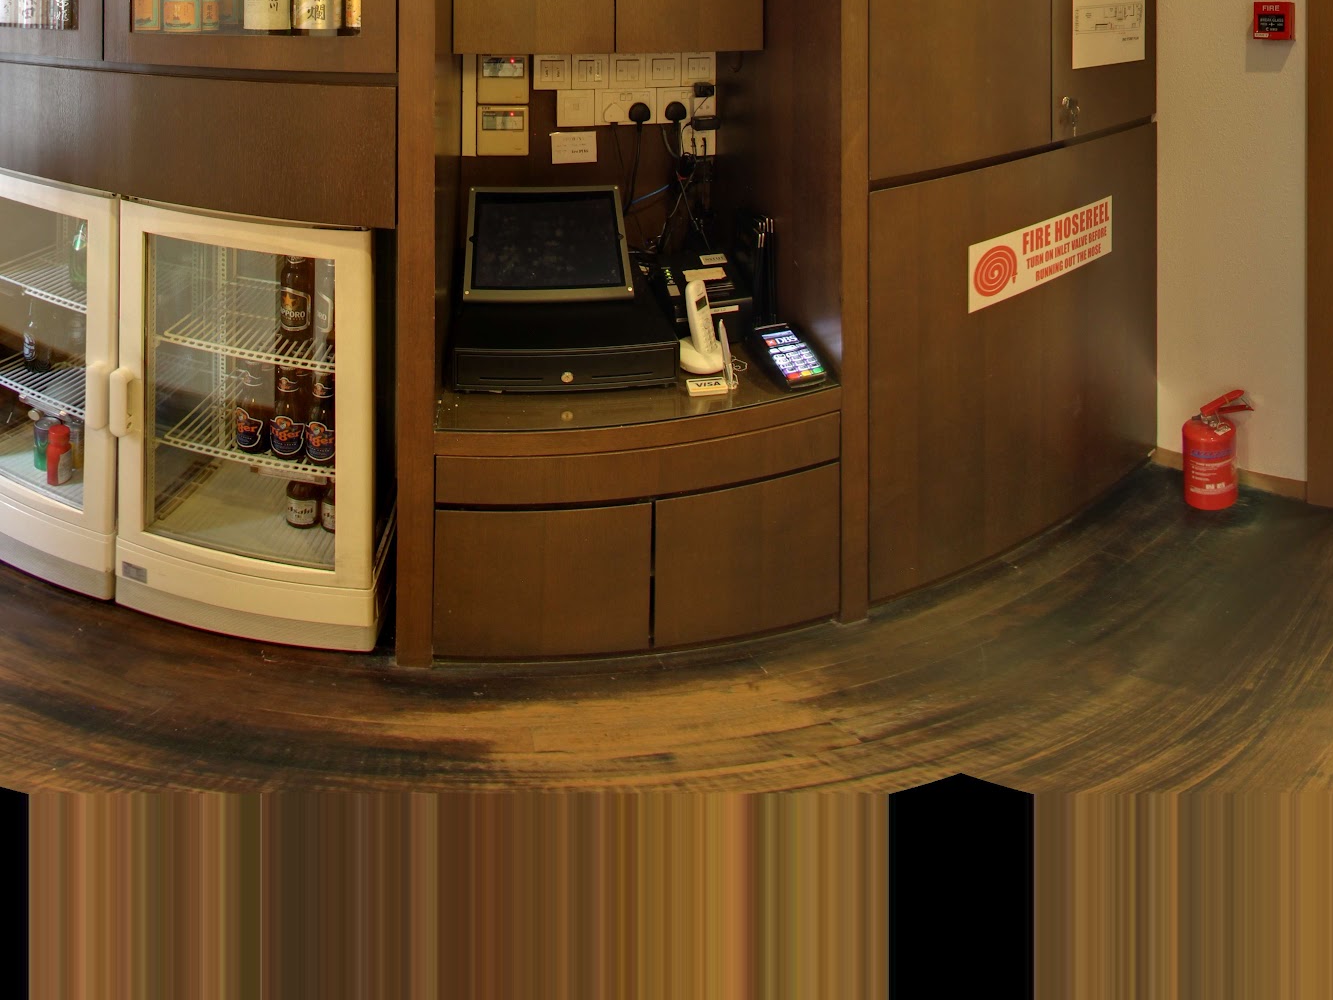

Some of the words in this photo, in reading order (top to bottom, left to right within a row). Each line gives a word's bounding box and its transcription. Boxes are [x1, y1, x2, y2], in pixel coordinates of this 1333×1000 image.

[1022, 223, 1051, 256] FIRE
[1055, 202, 1109, 242] HOSEREEL
[1026, 253, 1044, 269] TURN
[1045, 248, 1054, 262] ON
[1055, 242, 1070, 258] INLET
[1071, 234, 1088, 251] VALVE
[1088, 226, 1107, 244] BEFORE
[1036, 260, 1064, 282] RUNNING
[1064, 254, 1076, 269] OUT
[1076, 249, 1087, 263] THE
[1087, 243, 1102, 258] HOSE
[281, 307, 305, 318] PPORO
[775, 334, 799, 345] DBS
[694, 380, 722, 388] VISA
[237, 421, 258, 433] ger
